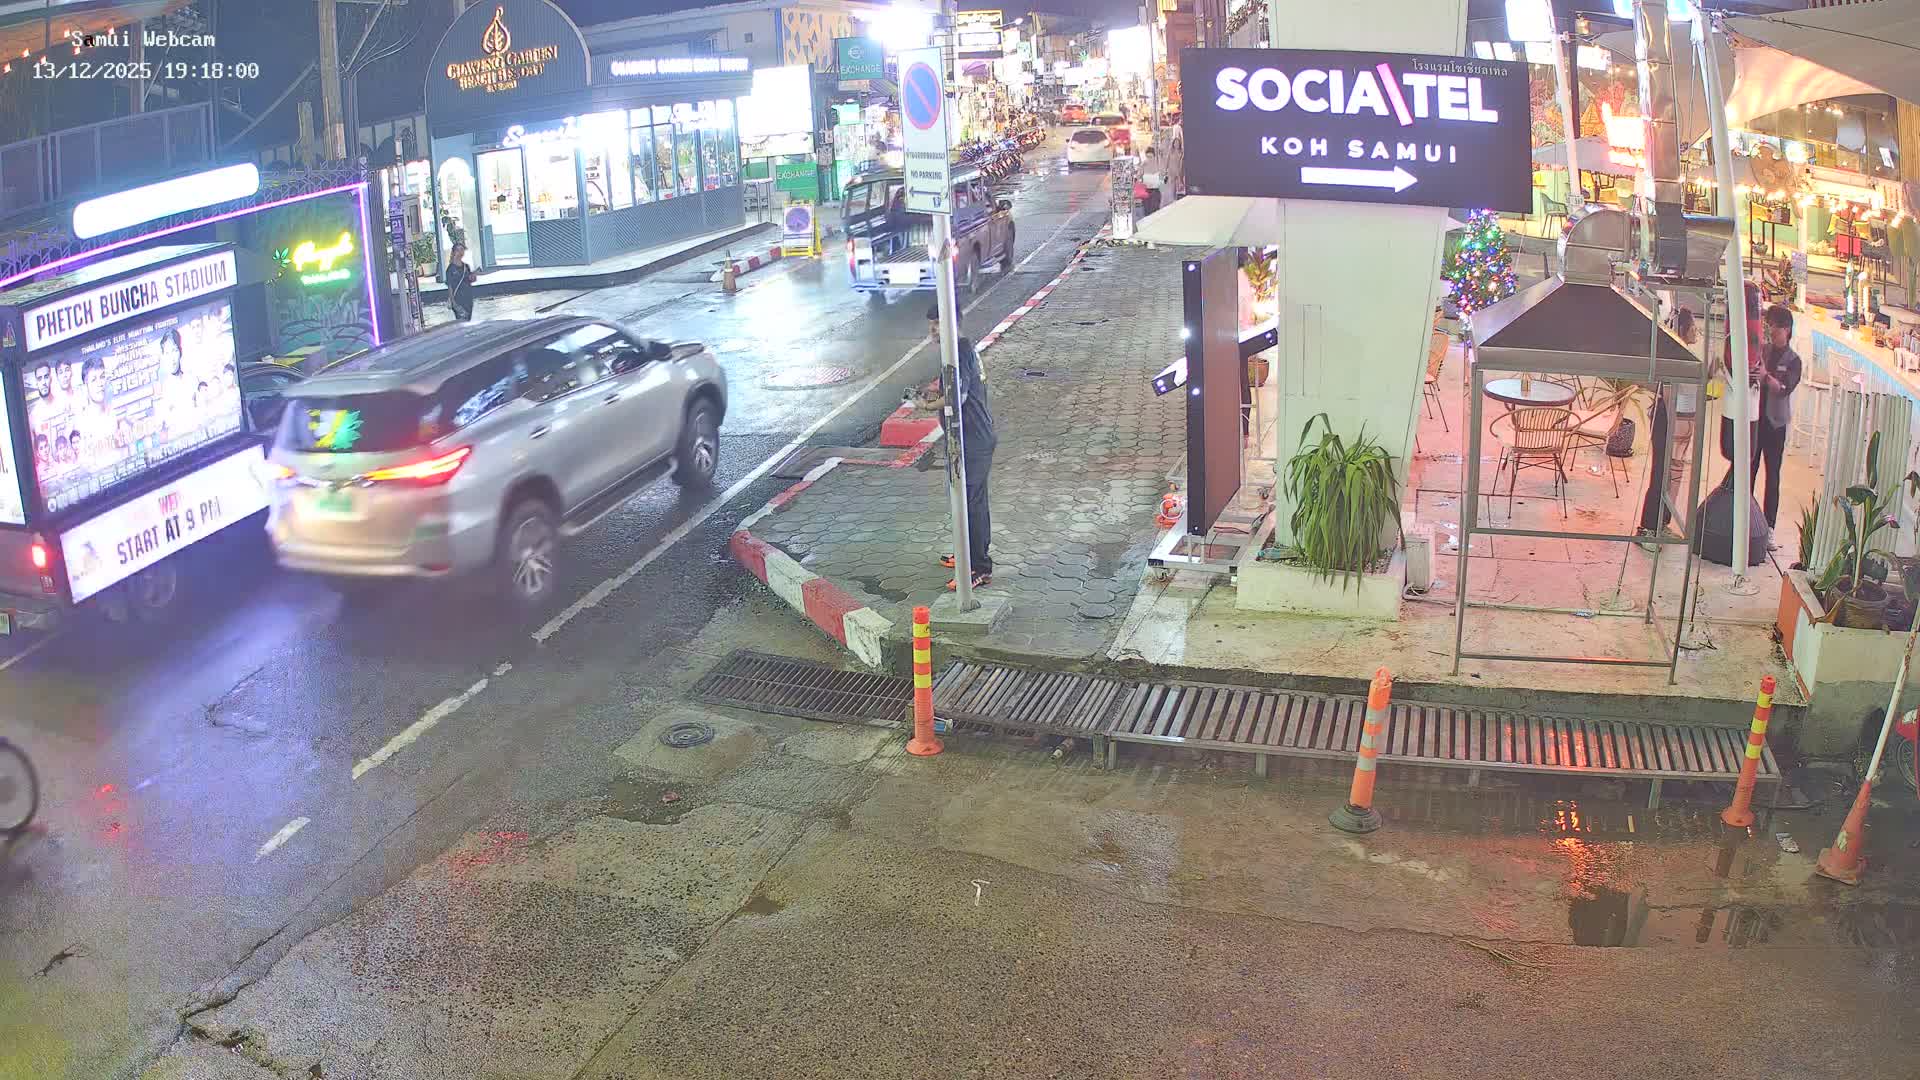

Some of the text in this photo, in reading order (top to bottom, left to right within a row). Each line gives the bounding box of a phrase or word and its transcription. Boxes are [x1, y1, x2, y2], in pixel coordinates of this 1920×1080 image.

[841, 63, 881, 74] EXCHANGE
[1261, 136, 1457, 163] KOH SAMUI
[777, 169, 816, 180] EXCHANGE
[911, 170, 943, 180] NO PARKING
[36, 259, 228, 341] PHETCH BUNCHA STADIUM
[117, 525, 160, 565] START
[165, 515, 181, 544] AT
[186, 508, 196, 531] 9
